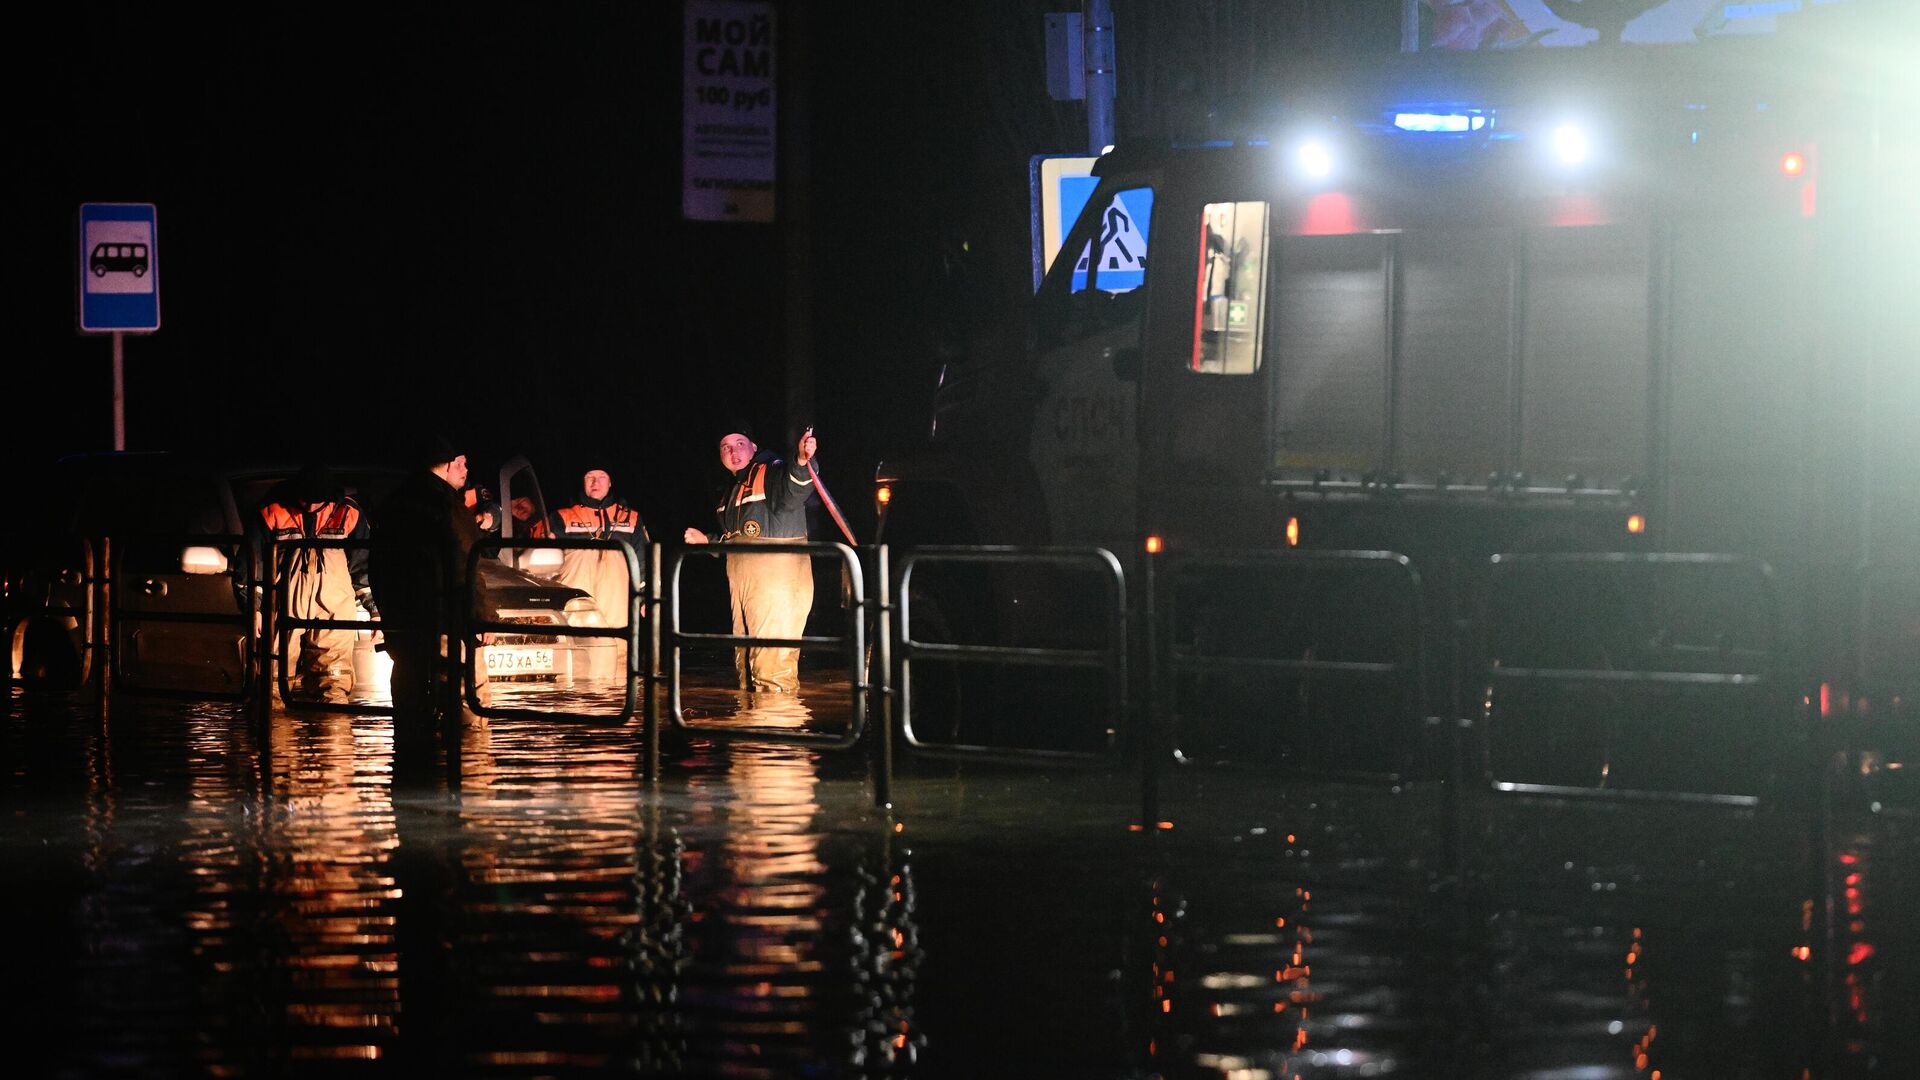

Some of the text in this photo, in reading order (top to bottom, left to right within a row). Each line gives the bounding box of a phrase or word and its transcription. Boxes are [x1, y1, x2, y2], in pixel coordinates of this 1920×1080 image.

[696, 13, 770, 46] МОЙ
[697, 46, 769, 77] САМ
[696, 85, 770, 112] 100 руб
